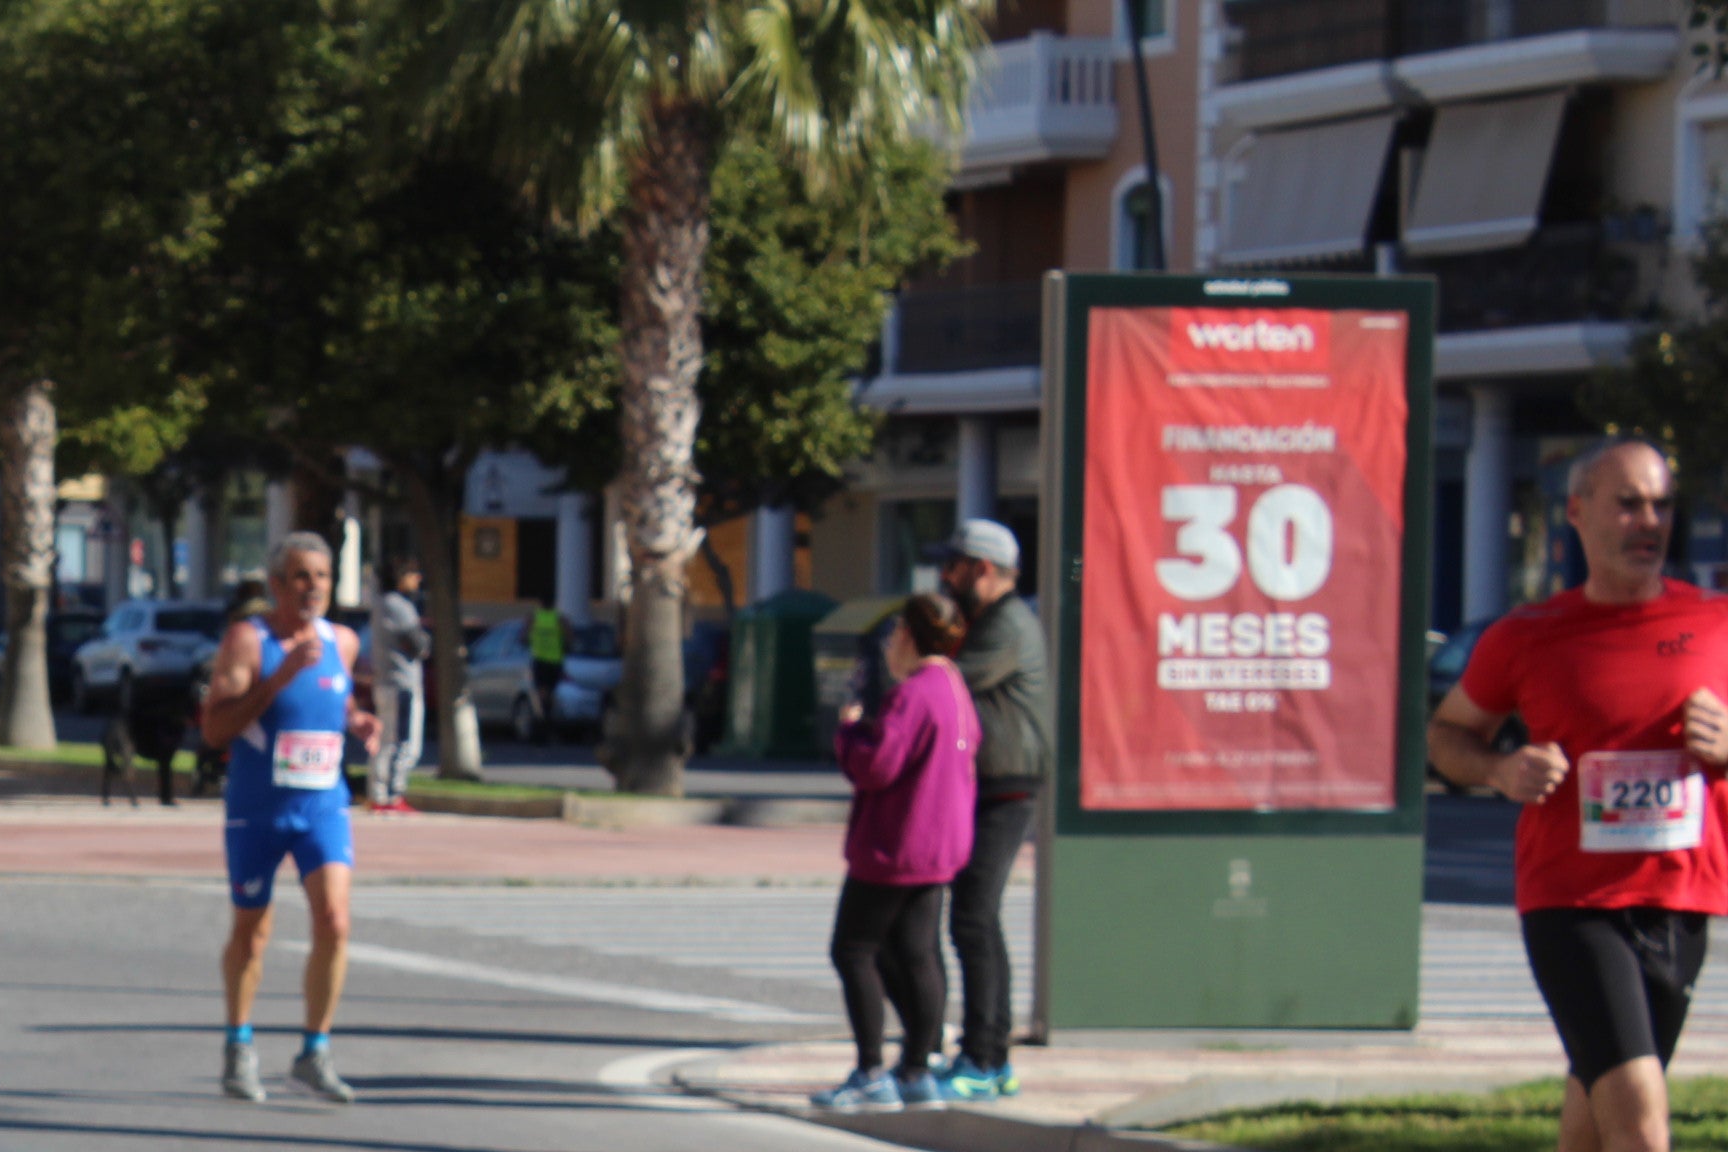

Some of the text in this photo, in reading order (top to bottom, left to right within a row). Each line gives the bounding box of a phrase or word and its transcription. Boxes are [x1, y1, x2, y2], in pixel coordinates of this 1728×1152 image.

[1186, 319, 1315, 352] worten
[1155, 483, 1333, 602] 30
[1157, 611, 1332, 658] MESES
[1612, 778, 1673, 809] 220
